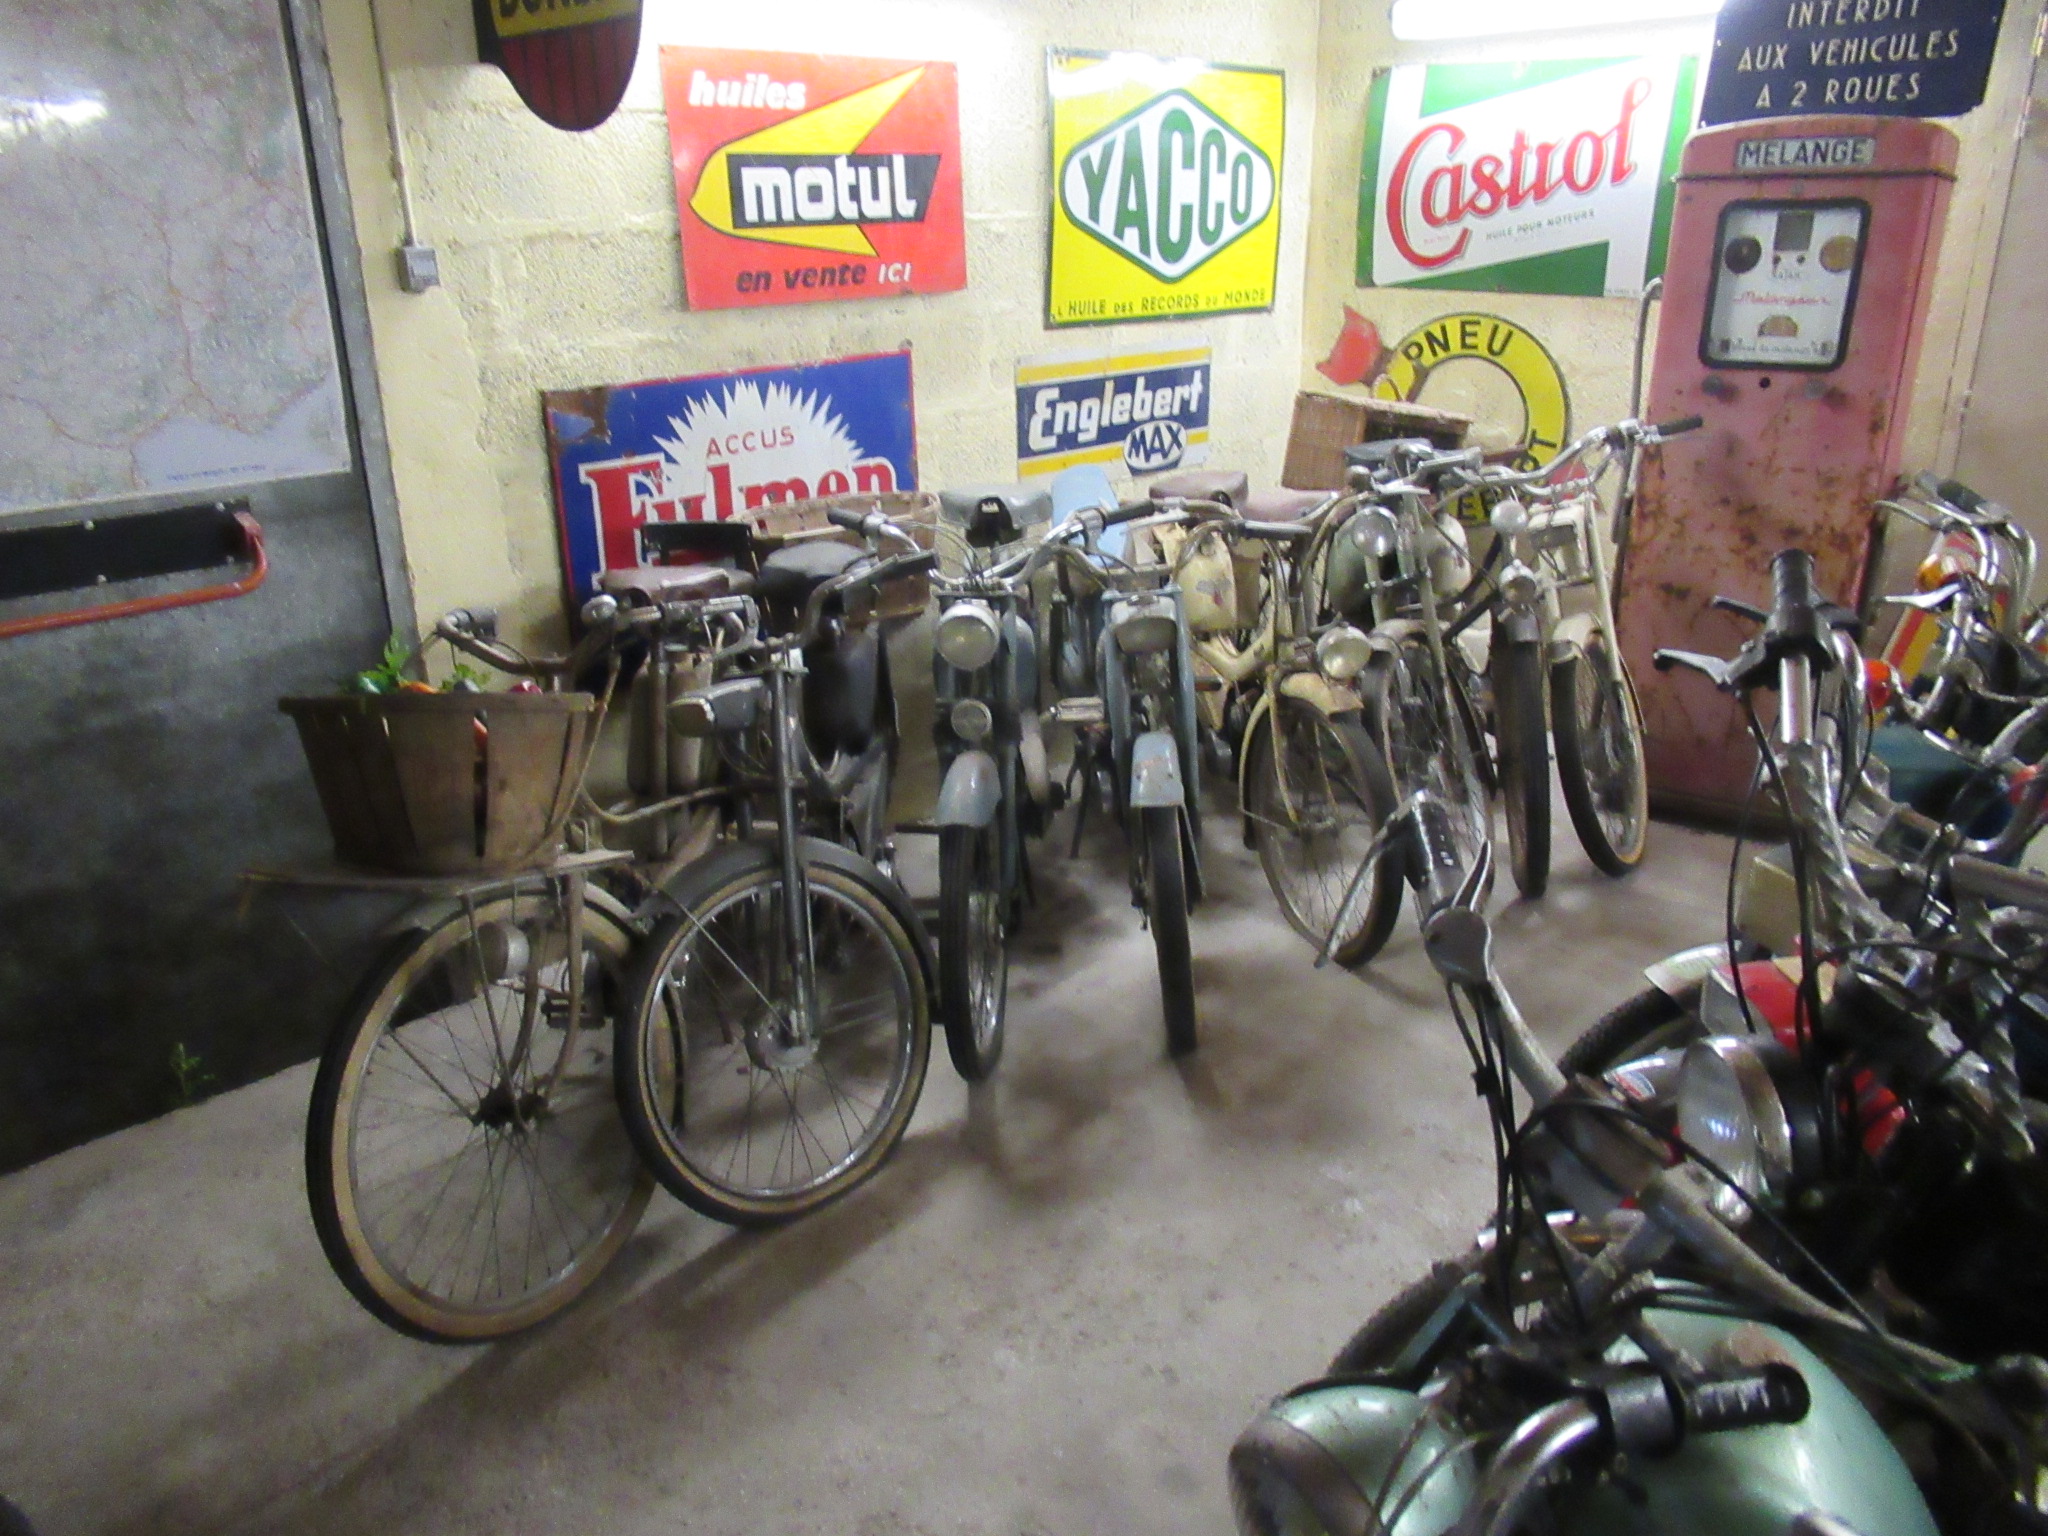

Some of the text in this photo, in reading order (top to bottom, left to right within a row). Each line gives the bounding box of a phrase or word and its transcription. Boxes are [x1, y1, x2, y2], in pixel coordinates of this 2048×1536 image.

[1785, 0, 1920, 29] INTERDIT
[1737, 29, 1960, 73] AUX VEHICULES
[688, 70, 808, 110] huiles
[1754, 71, 1921, 109] A 2 ROUES
[1385, 76, 1652, 269] Castrol
[1741, 138, 1867, 166] MELANGE
[740, 153, 918, 224] motul
[1078, 106, 1255, 265] YACCO
[736, 261, 912, 294] en vente ICI
[1141, 294, 1200, 312] RECORDS
[1223, 287, 1266, 305] MONDE
[1401, 318, 1514, 363] PNEU
[1028, 368, 1204, 453] Englebert
[705, 424, 796, 459] ACCUS
[1126, 422, 1184, 464] MAX
